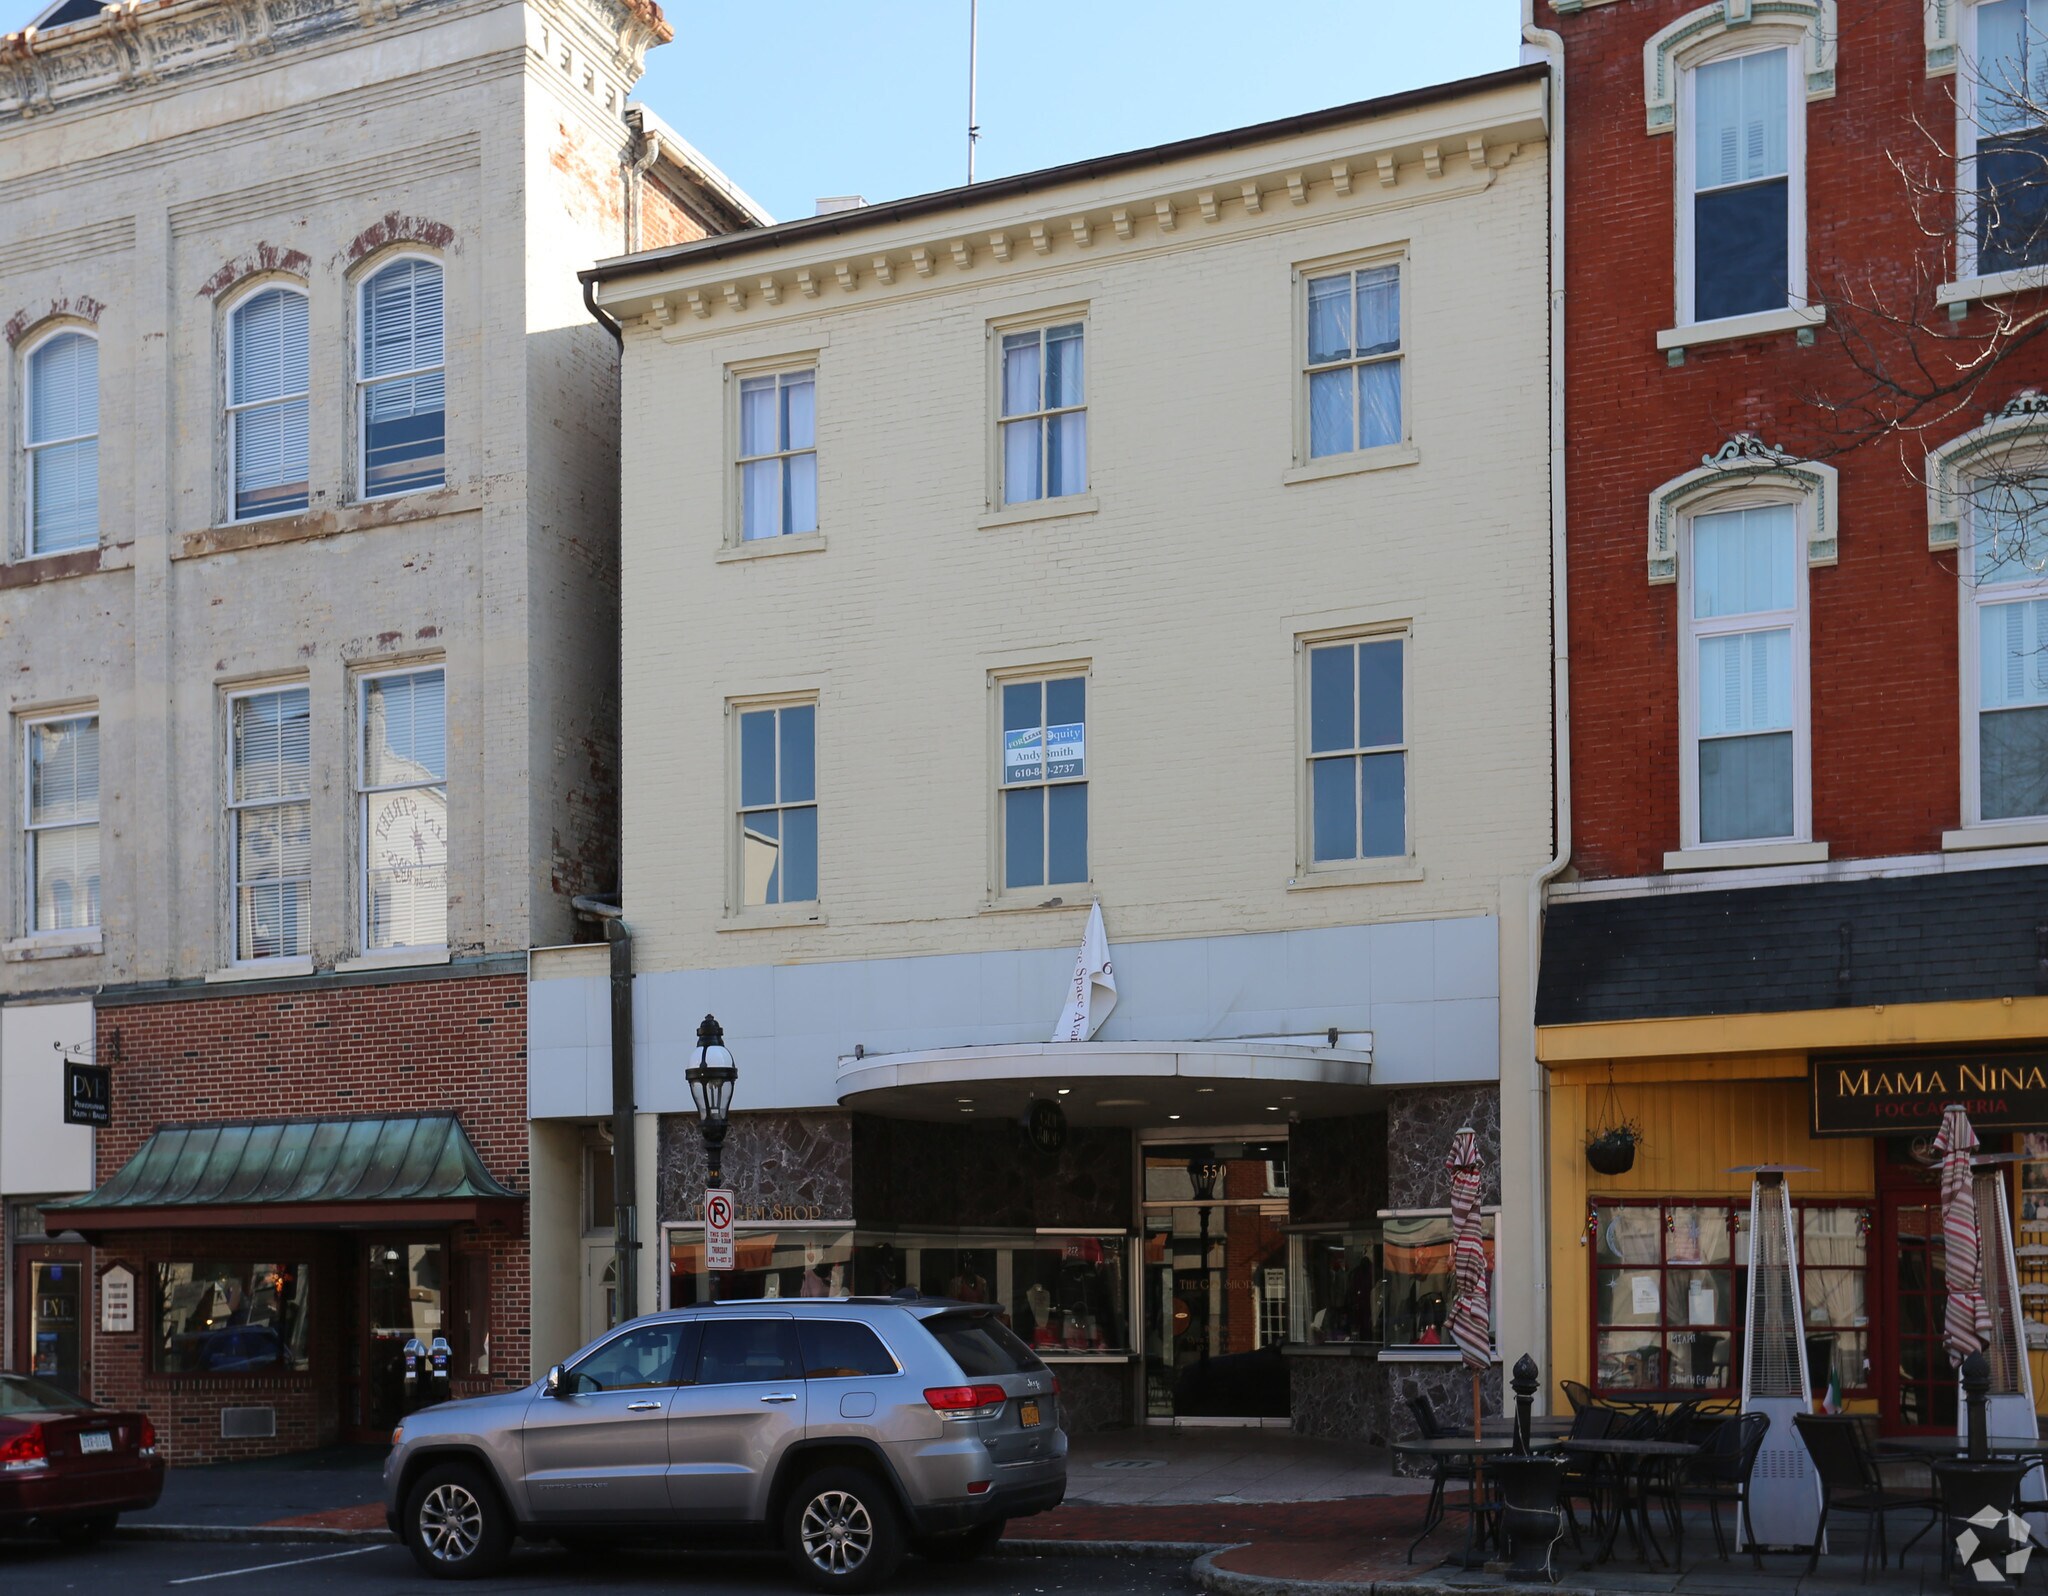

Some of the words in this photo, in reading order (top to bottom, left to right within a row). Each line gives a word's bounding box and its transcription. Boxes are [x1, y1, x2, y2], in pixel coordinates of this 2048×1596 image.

[1015, 749, 1041, 761] Andy
[1046, 747, 1074, 758] Smith
[1073, 967, 1087, 1008] Space
[1837, 1068, 1948, 1097] MAMA
[1957, 1063, 2048, 1093] NINA
[1203, 1164, 1227, 1179] 550
[771, 1203, 822, 1220] SHOP
[1670, 1333, 1696, 1345] MIAMI
